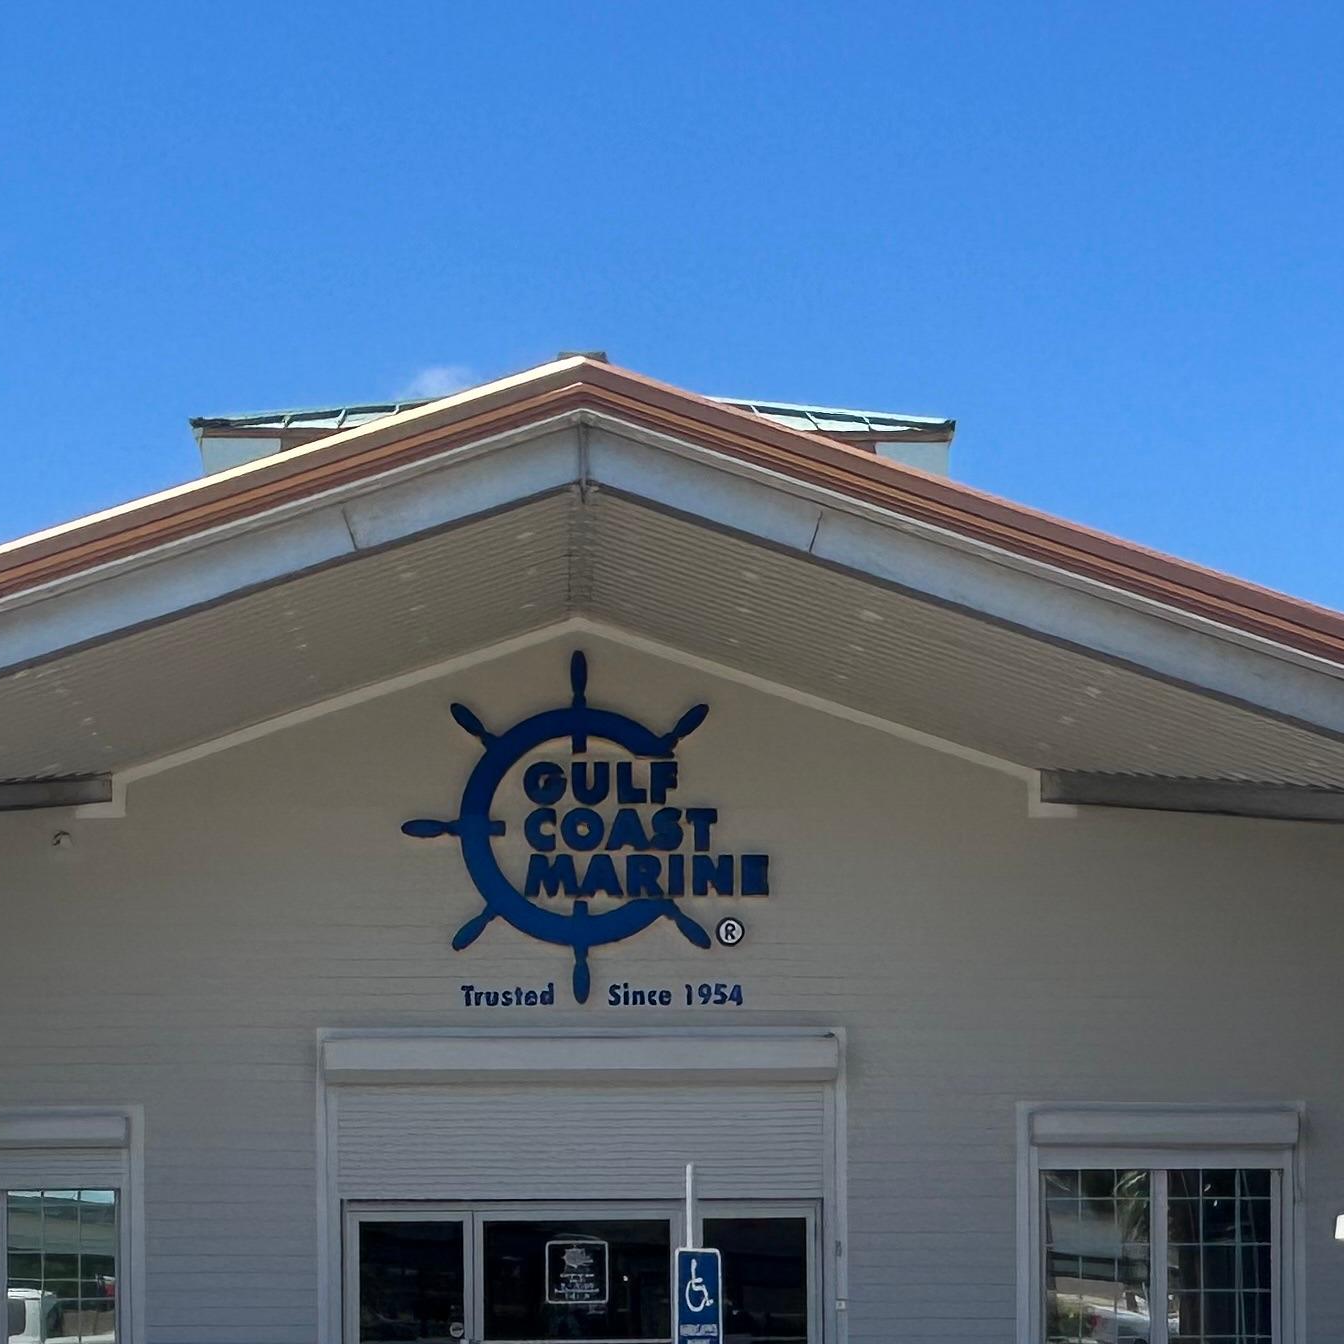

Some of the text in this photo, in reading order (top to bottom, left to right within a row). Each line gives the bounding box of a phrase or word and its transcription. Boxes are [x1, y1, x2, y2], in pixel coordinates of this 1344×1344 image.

[523, 761, 678, 805] GULF
[523, 807, 718, 852] COAST
[524, 853, 769, 898] MARINE
[460, 982, 744, 1007] Trusted Since 1954
